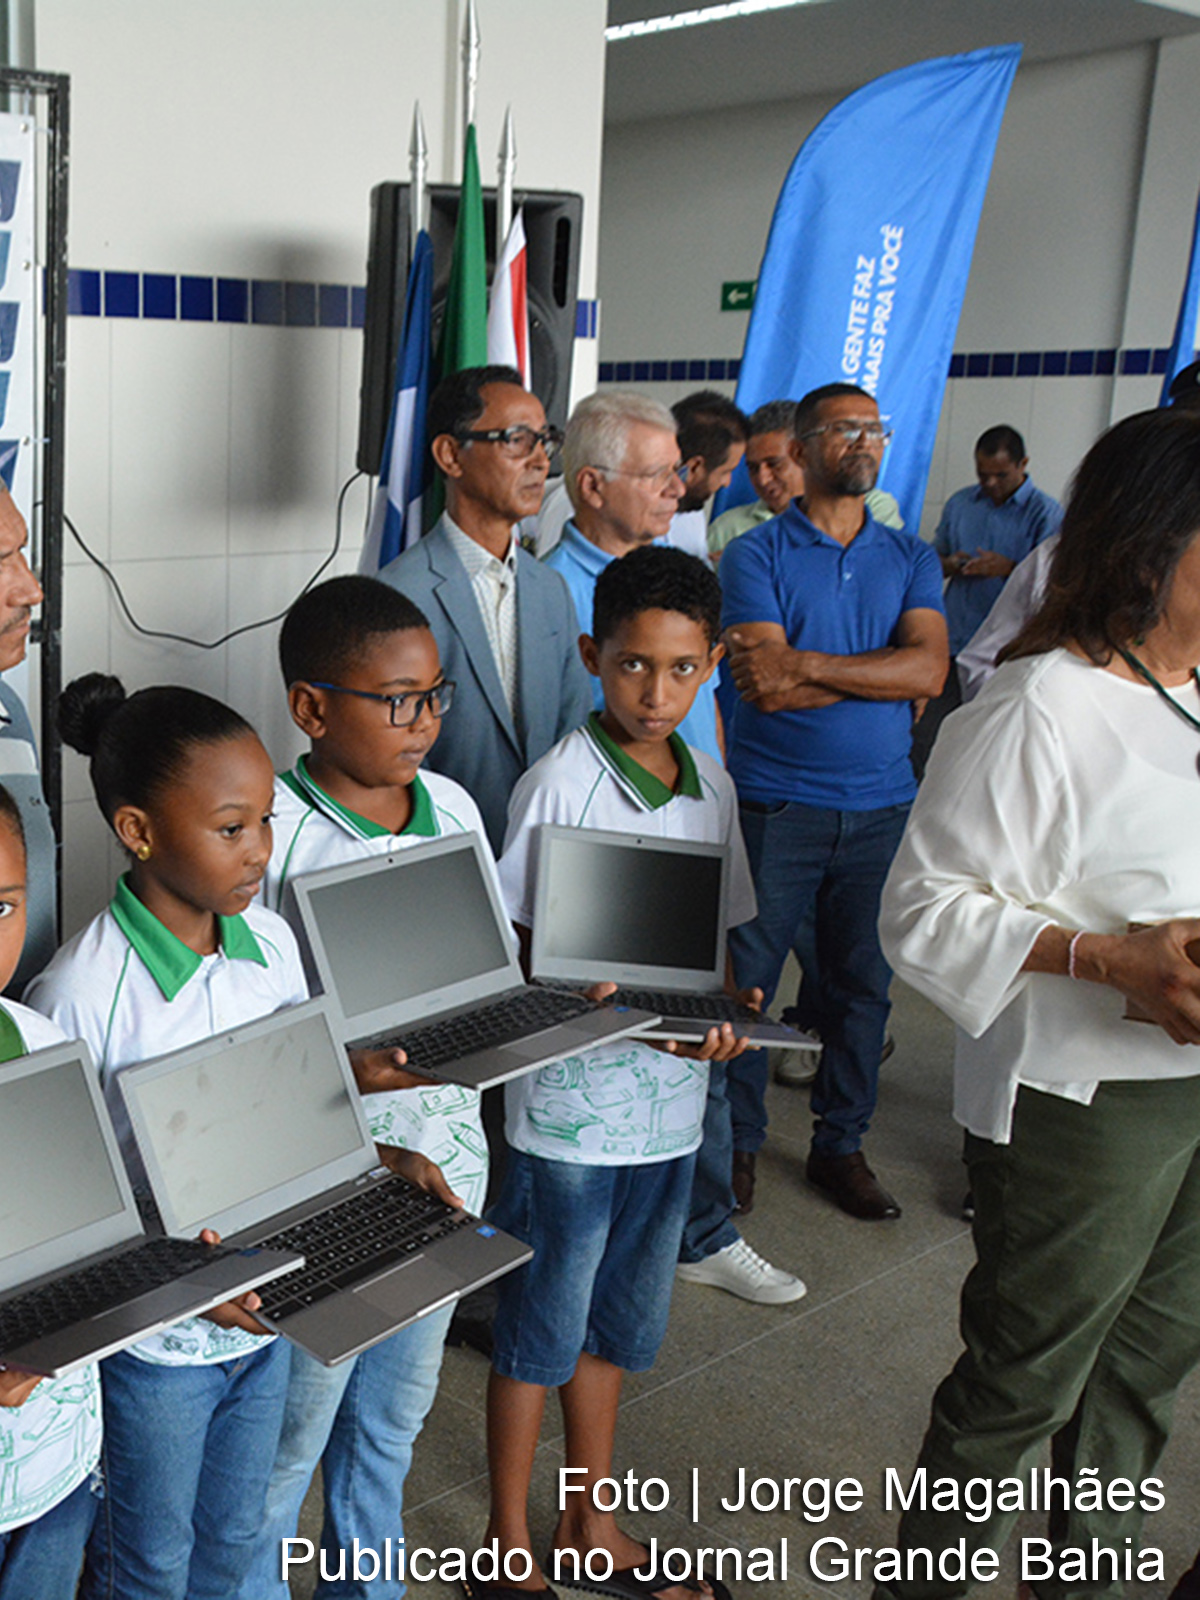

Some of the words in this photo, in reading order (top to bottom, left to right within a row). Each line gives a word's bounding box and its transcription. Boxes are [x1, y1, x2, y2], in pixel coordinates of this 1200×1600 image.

[853, 255, 876, 299] FAZ
[879, 223, 904, 288] VOCÊ
[841, 300, 870, 375] GENTE
[871, 290, 896, 336] PRA
[861, 336, 885, 397] MAIS
